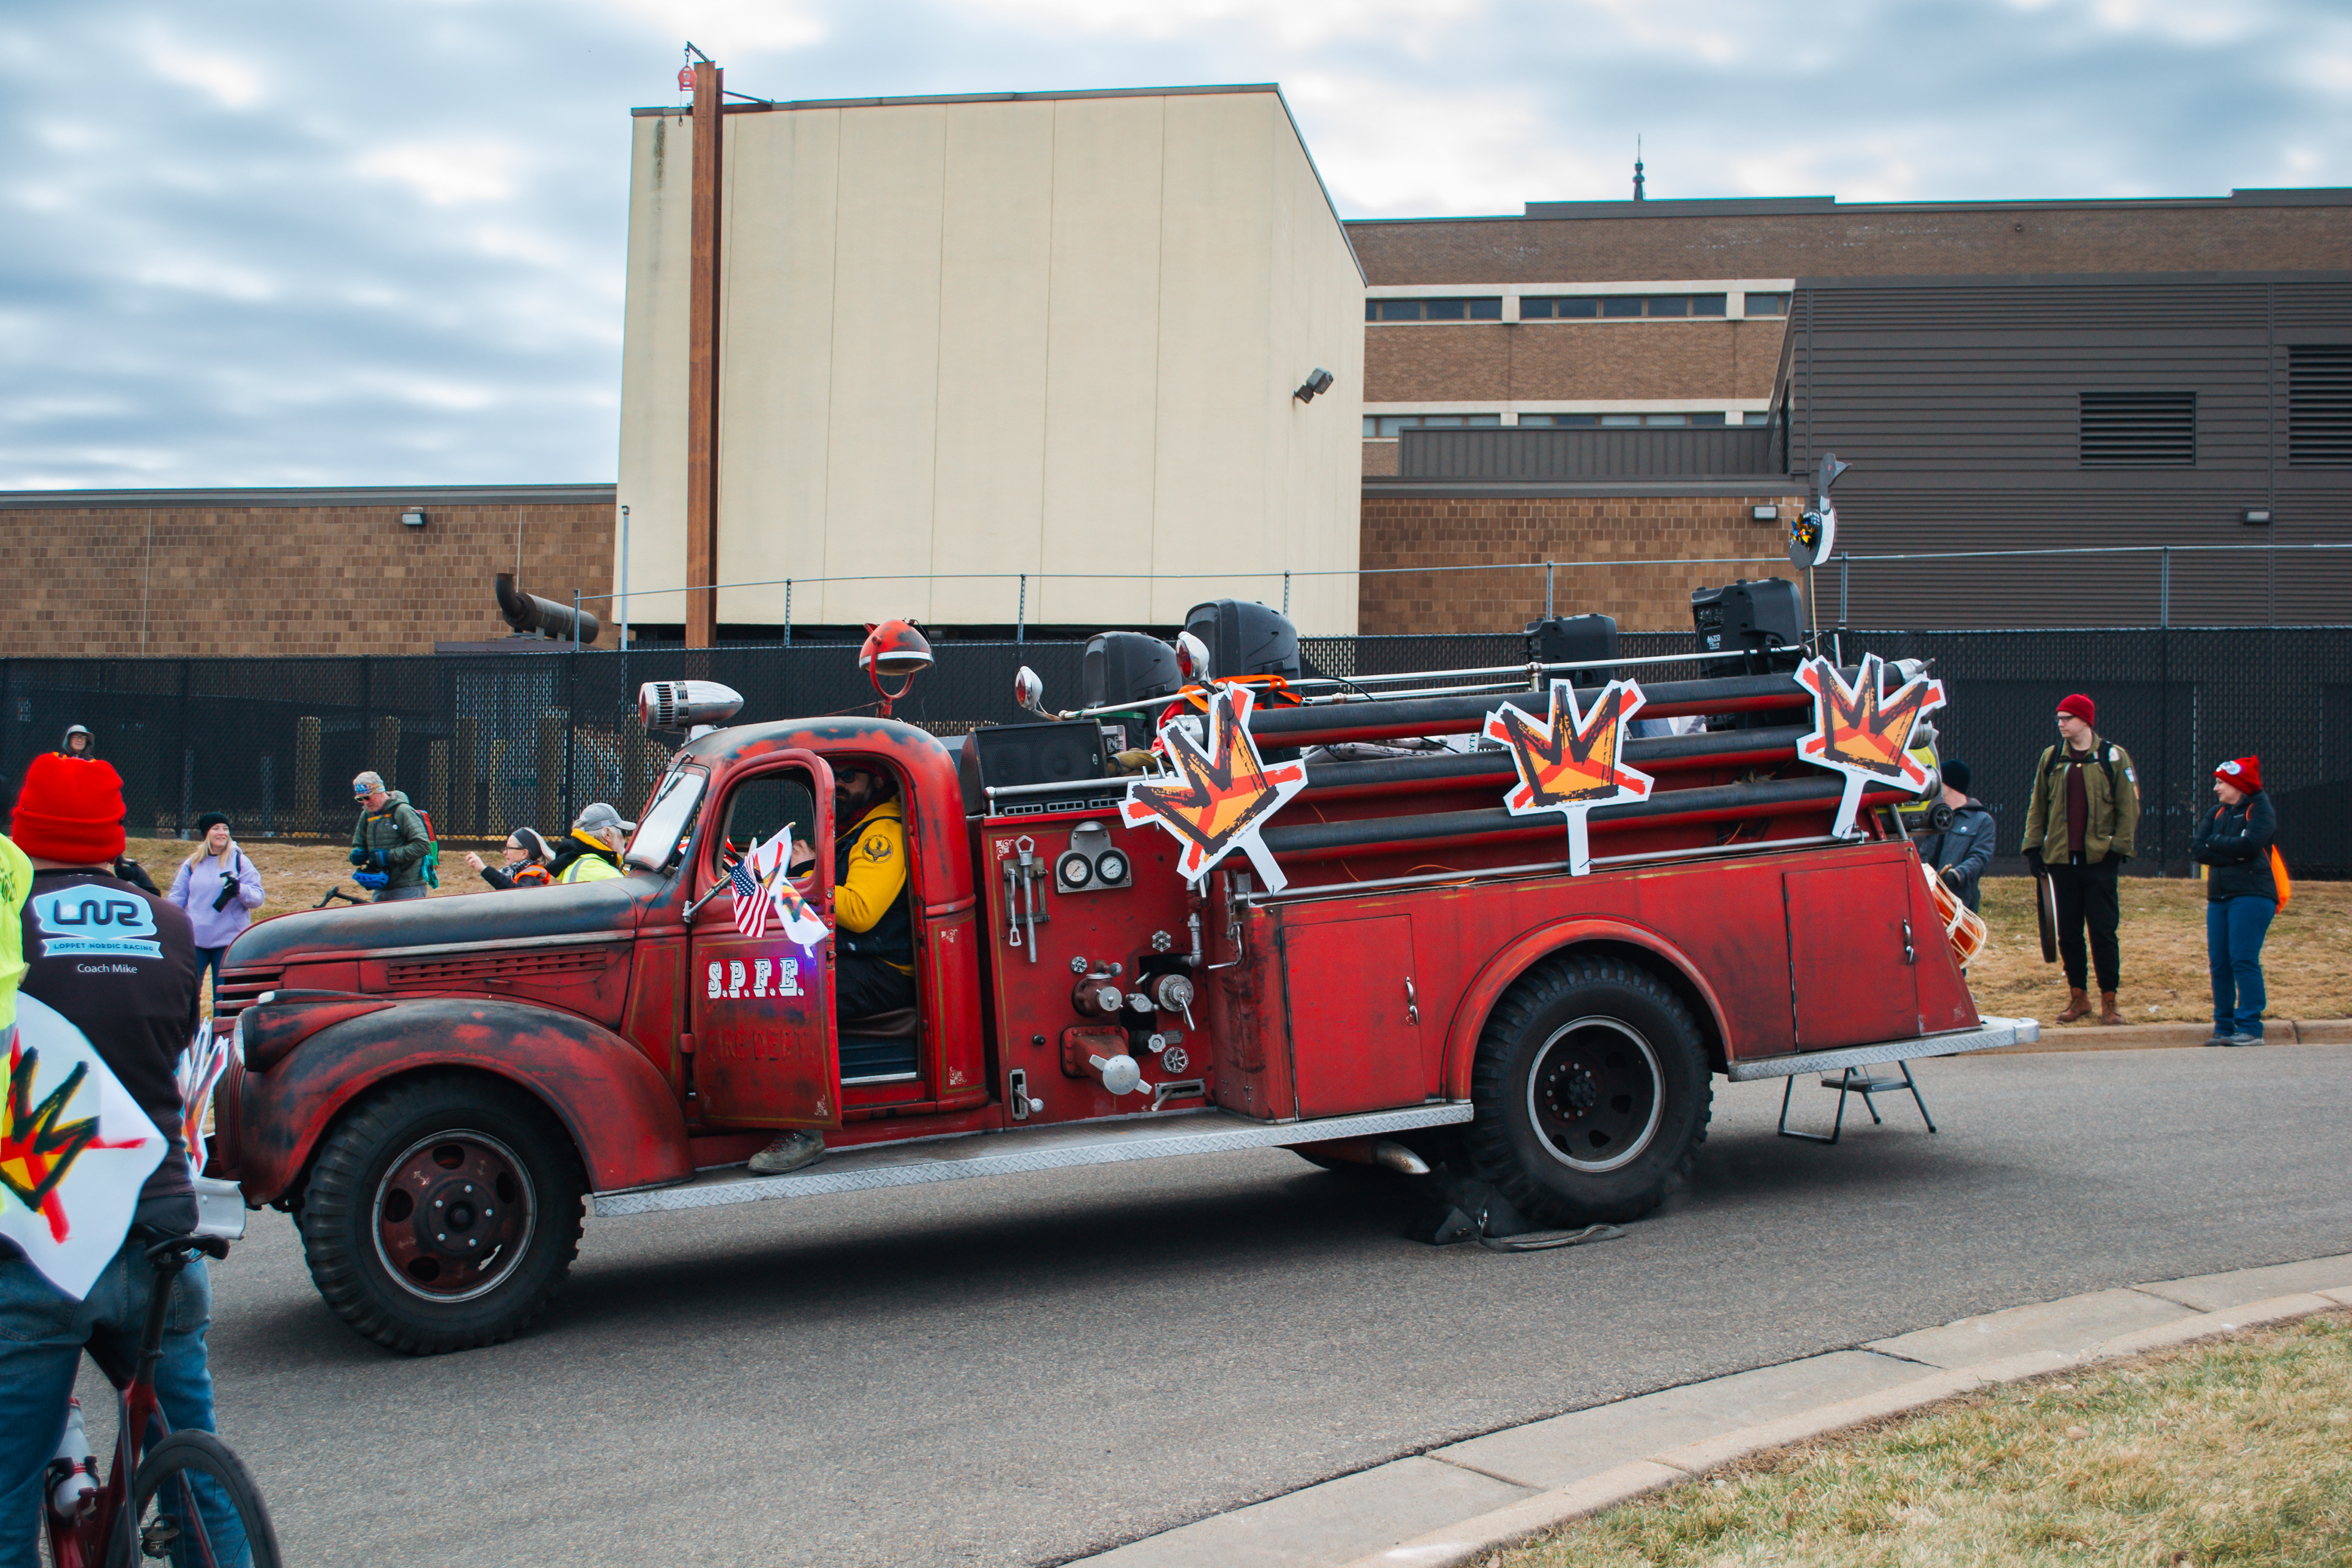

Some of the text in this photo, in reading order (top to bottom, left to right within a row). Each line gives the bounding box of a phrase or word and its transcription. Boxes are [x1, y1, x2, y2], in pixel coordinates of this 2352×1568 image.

[54, 899, 144, 927] LNR
[77, 963, 138, 973] Coach Mike
[707, 956, 805, 999] S.P.F.E.
[707, 1028, 747, 1061] FIRE
